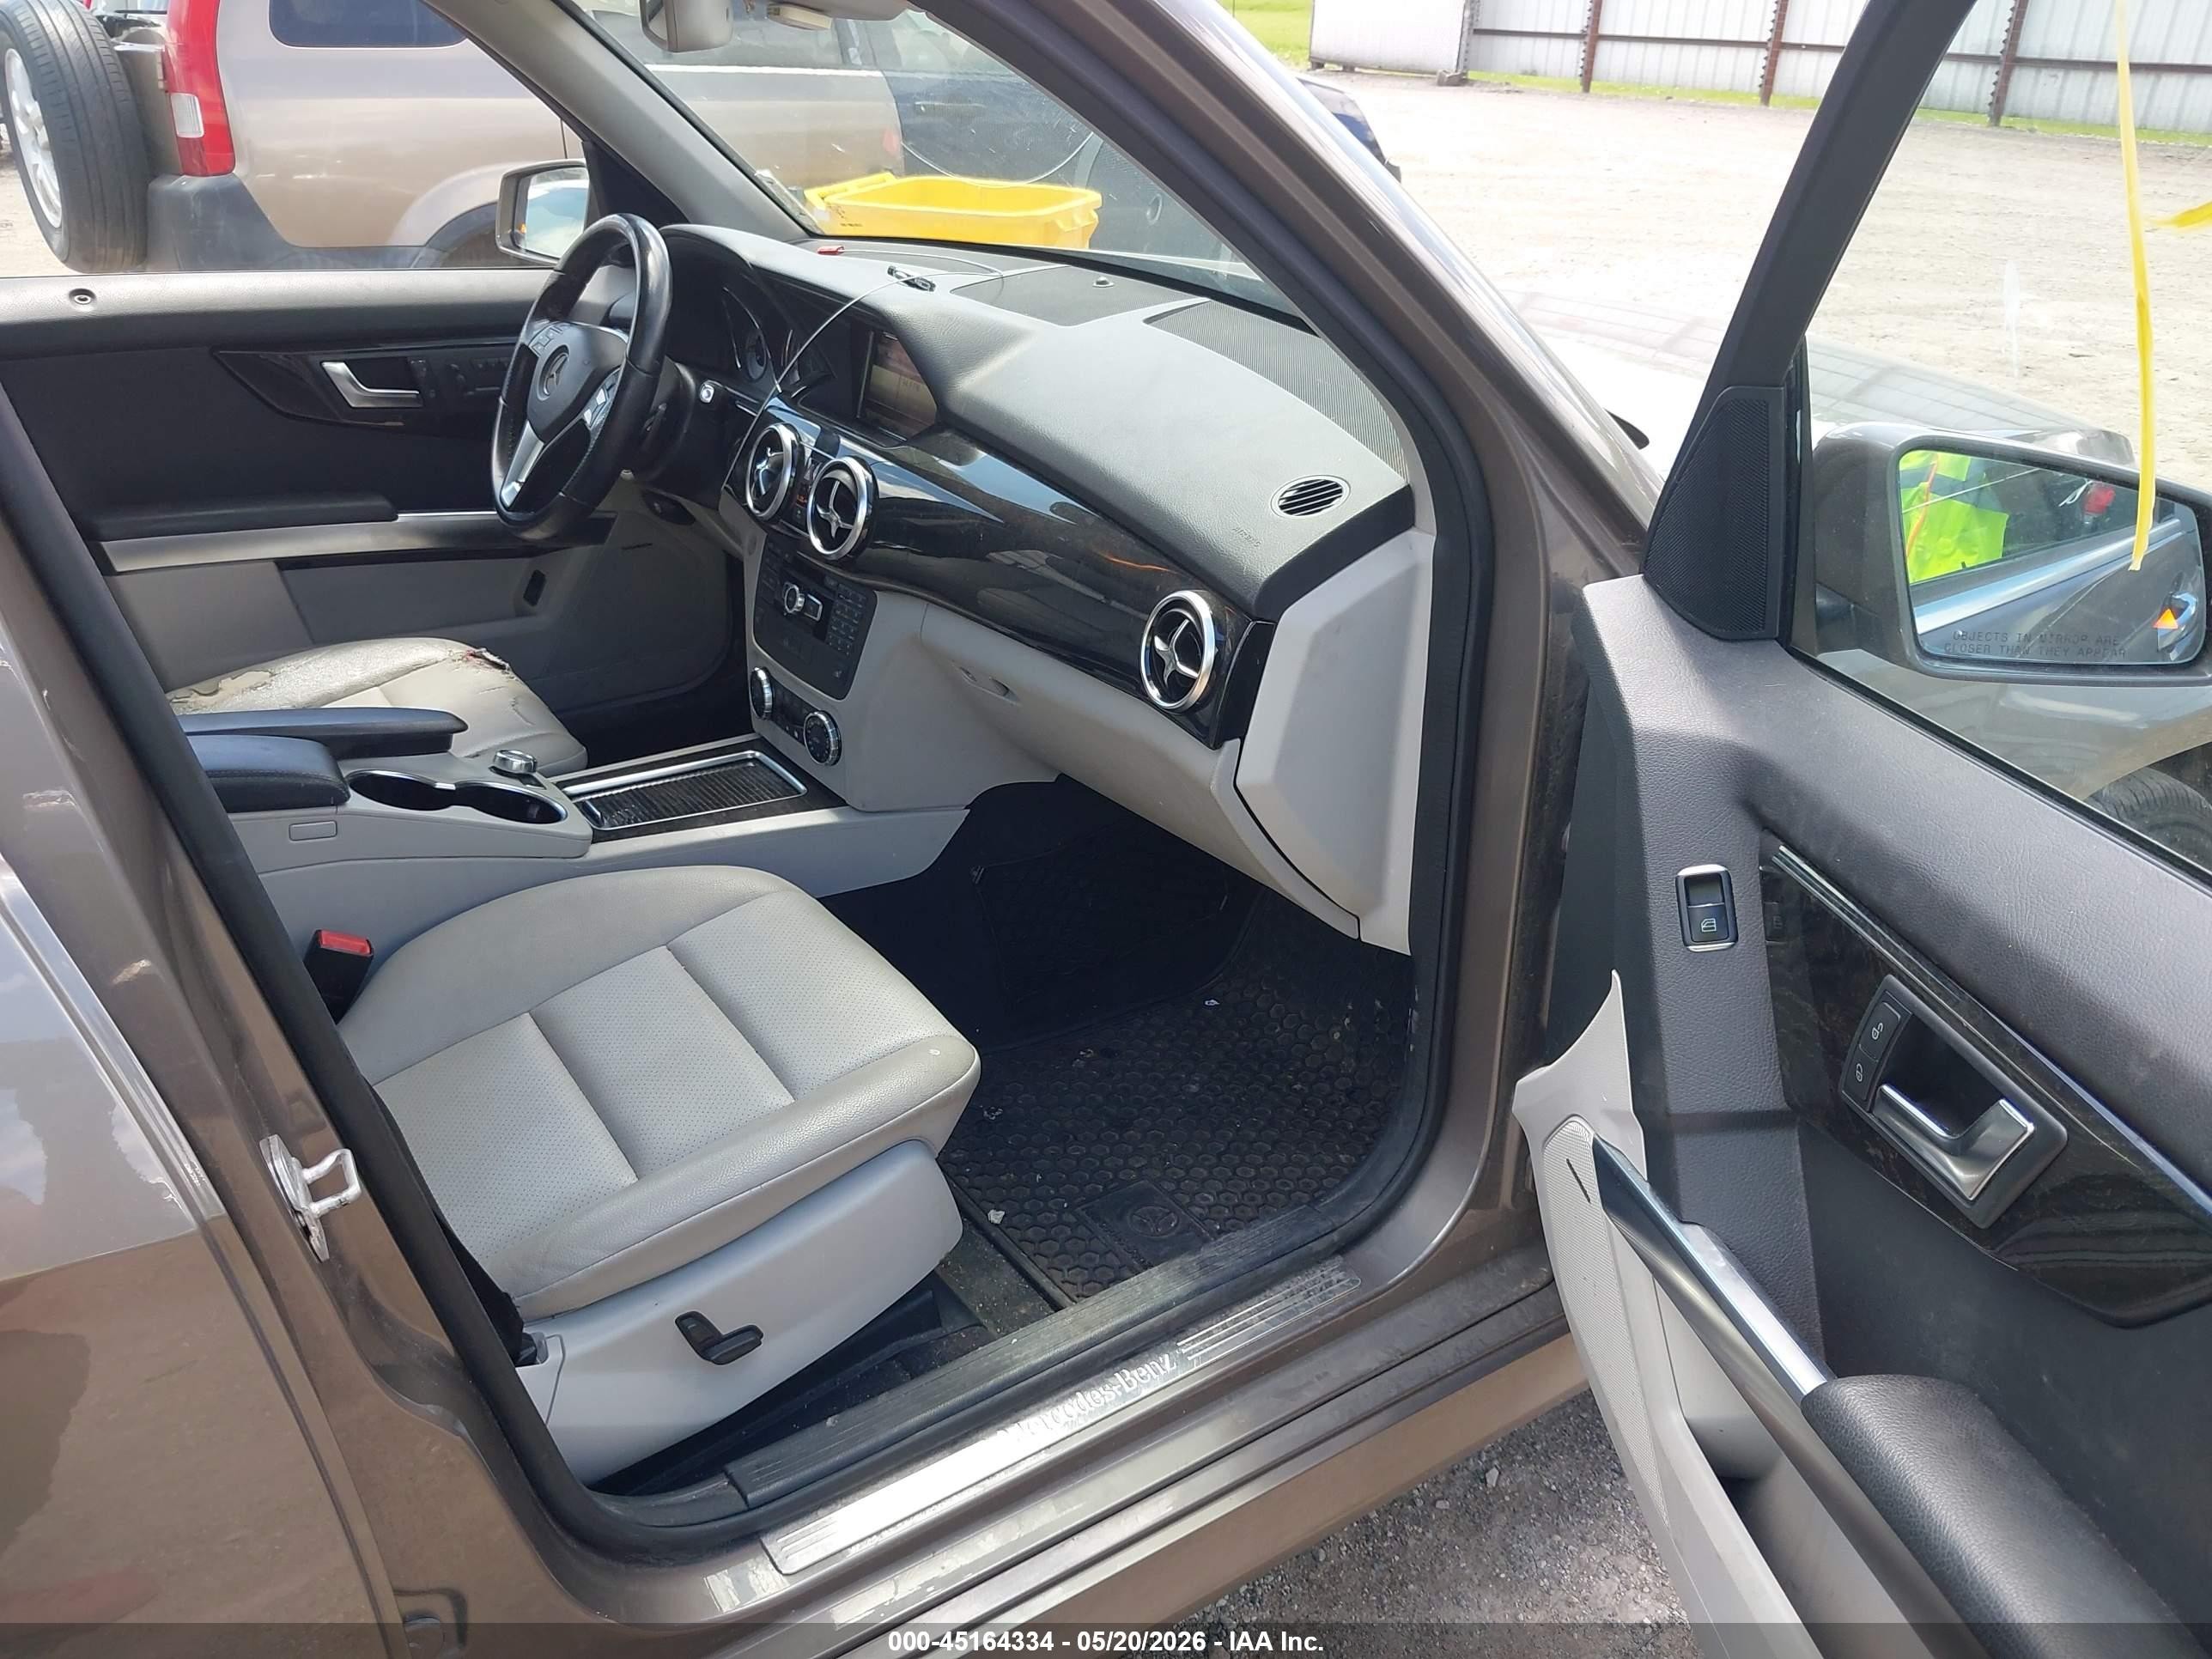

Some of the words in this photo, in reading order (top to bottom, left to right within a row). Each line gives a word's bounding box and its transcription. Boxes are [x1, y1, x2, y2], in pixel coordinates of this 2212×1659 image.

[1953, 630, 2008, 642] OBJECTS
[2016, 632, 2032, 643] IN
[2039, 632, 2088, 646] MIRROR
[2095, 634, 2119, 646] ARE
[1943, 642, 1991, 654] CLOSER
[2000, 644, 2030, 656] THAN
[2039, 645, 2069, 657] THEY
[2077, 647, 2126, 659] APPEAR
